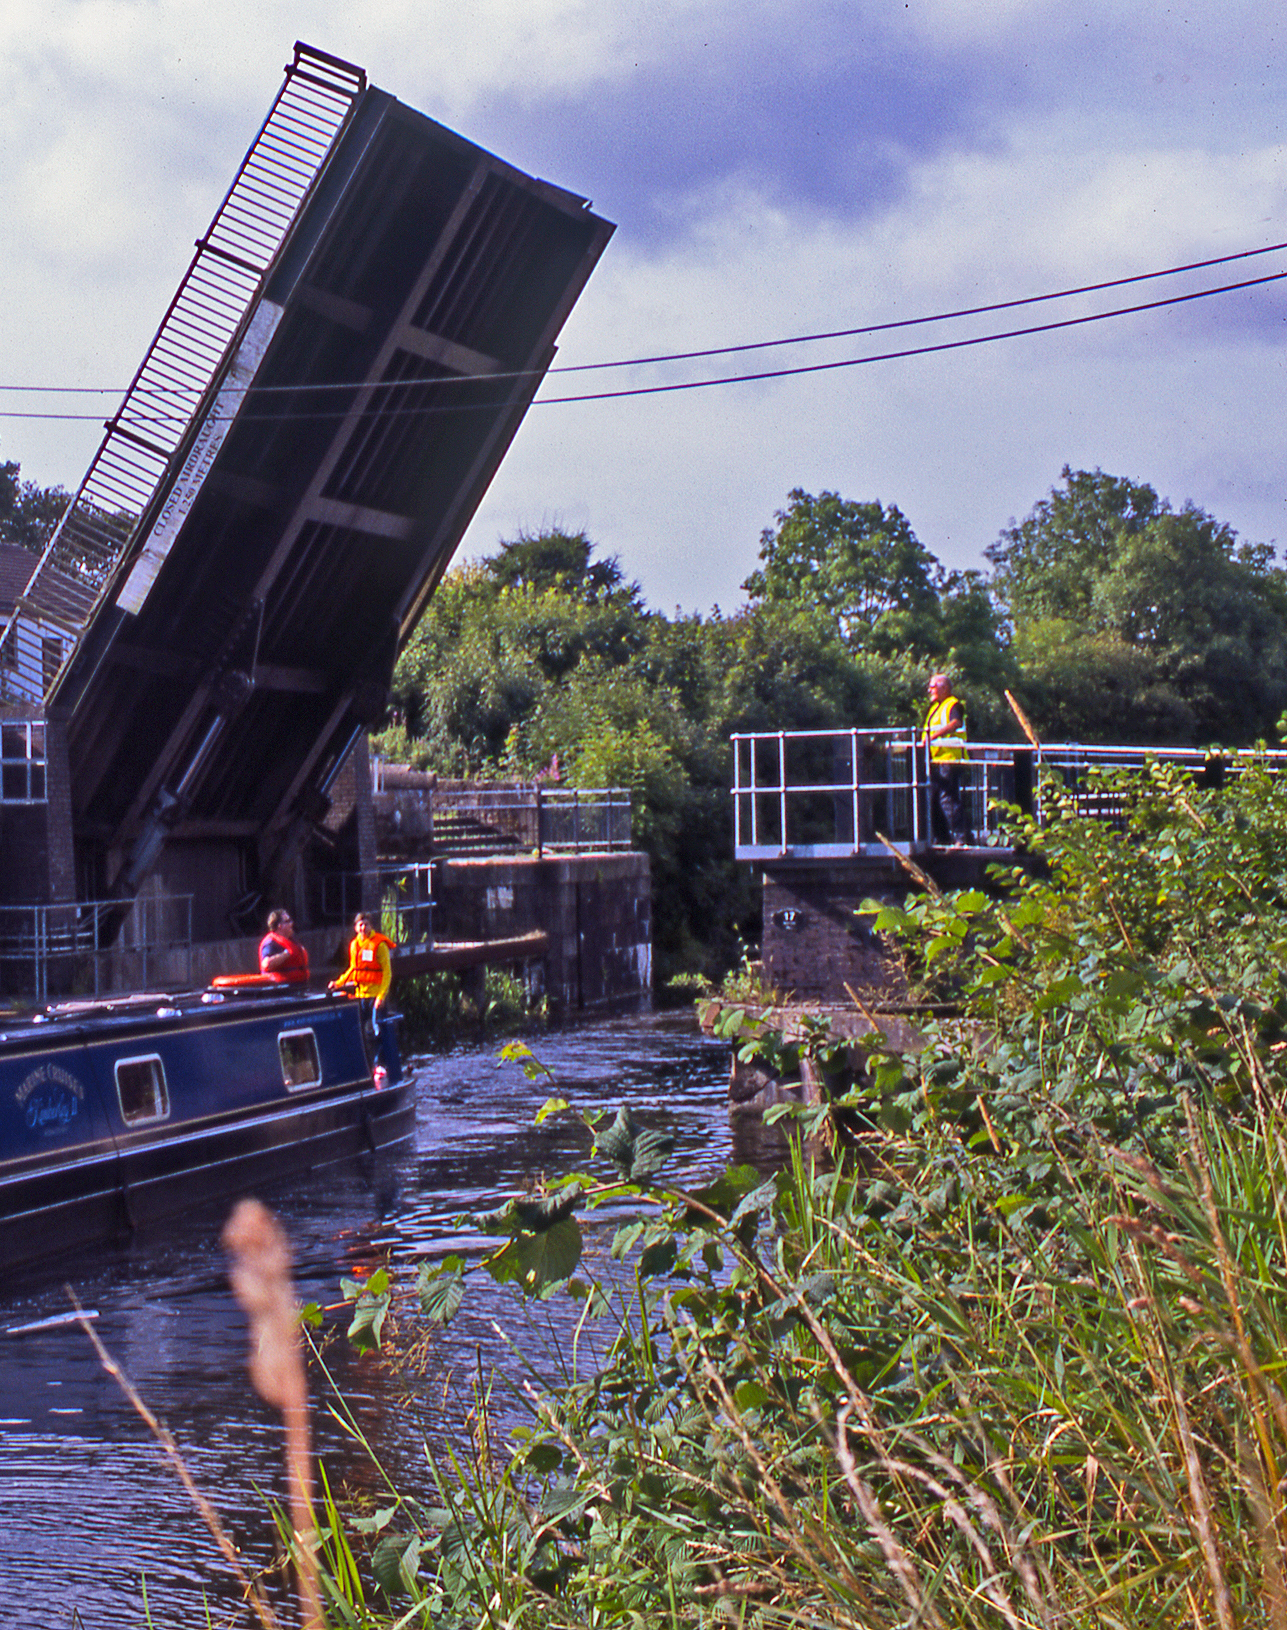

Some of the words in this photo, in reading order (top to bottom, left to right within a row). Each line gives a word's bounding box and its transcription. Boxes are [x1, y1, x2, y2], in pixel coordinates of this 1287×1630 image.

[153, 487, 183, 537] CLOSED
[179, 402, 224, 483] AIRDRAUGHT
[192, 434, 222, 485] METRES
[784, 911, 795, 921] 17
[15, 1066, 45, 1108] MARINE
